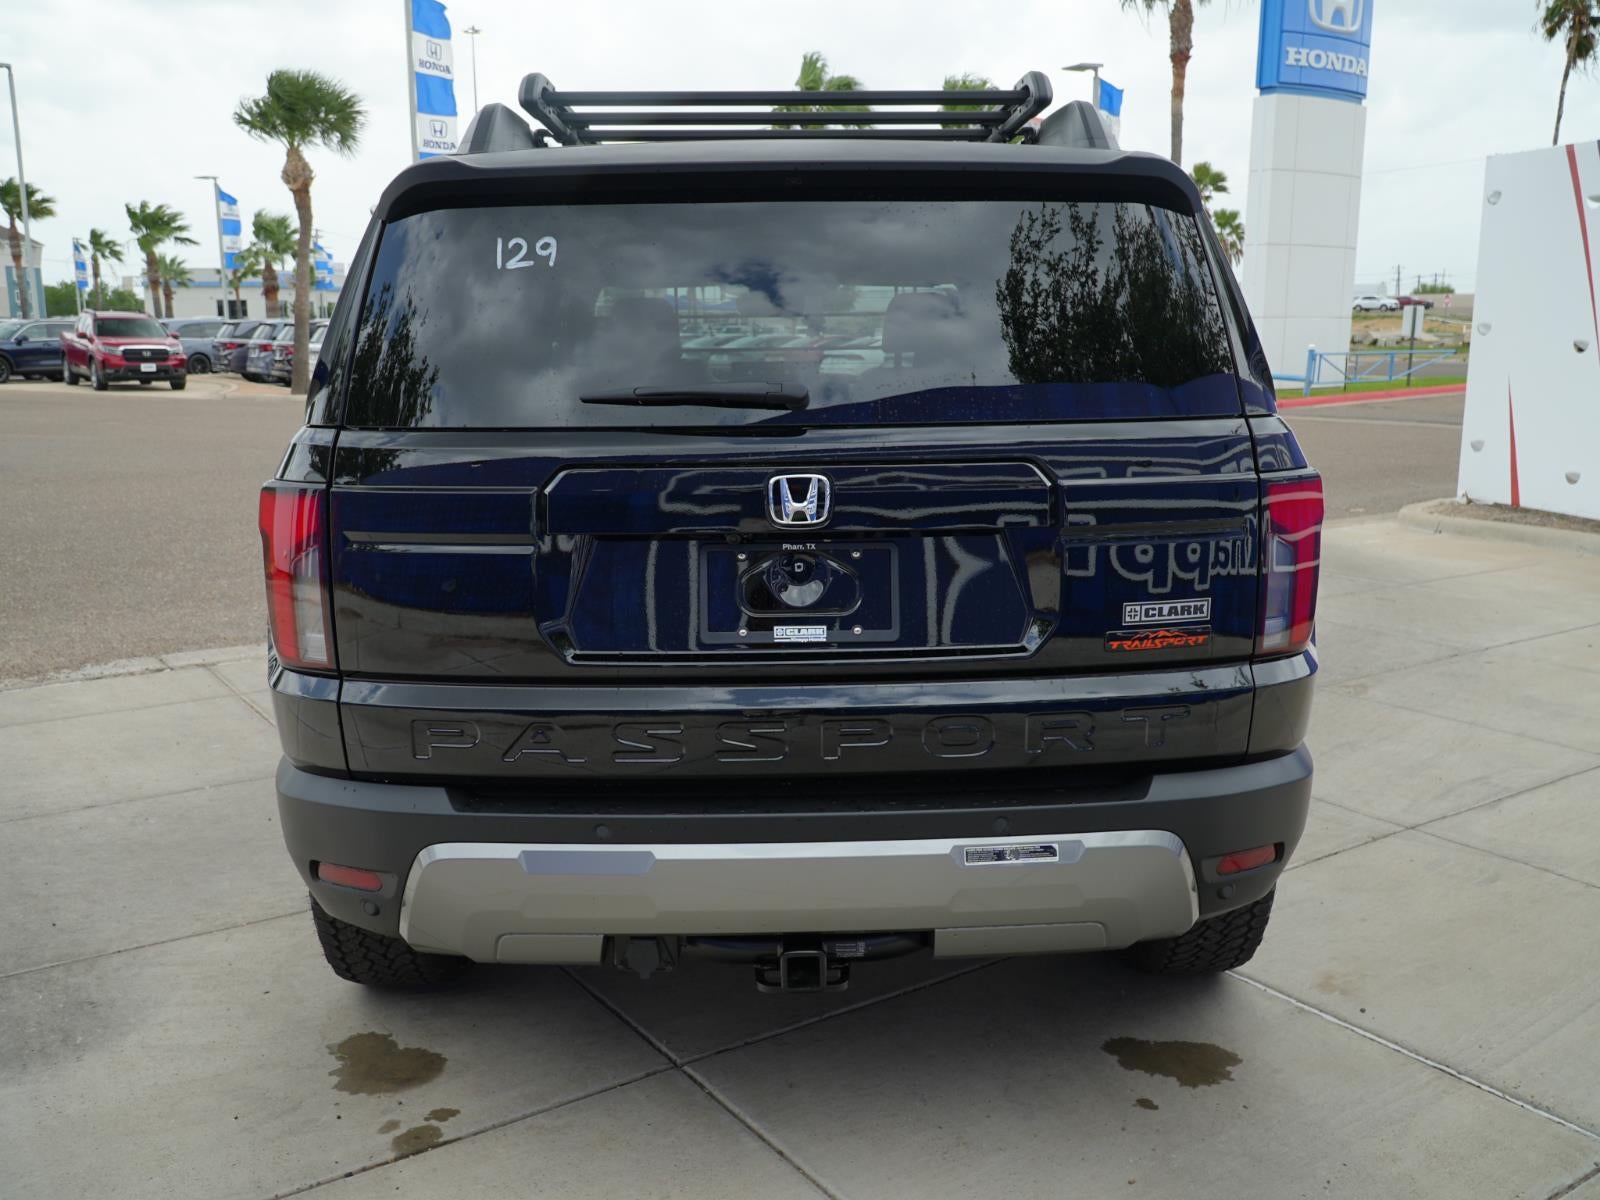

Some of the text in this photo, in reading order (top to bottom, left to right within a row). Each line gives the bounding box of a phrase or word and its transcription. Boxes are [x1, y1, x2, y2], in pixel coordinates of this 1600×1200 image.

[418, 58, 452, 75] HONDA
[1285, 46, 1368, 77] HONDA
[422, 138, 457, 151] HONDA
[496, 236, 557, 269] 129
[806, 543, 817, 551] TX
[1143, 603, 1206, 619] CLARK
[784, 627, 826, 637] CLARK
[1108, 634, 1209, 651] TRAILSPORT
[411, 704, 1191, 763] PASSPORT
